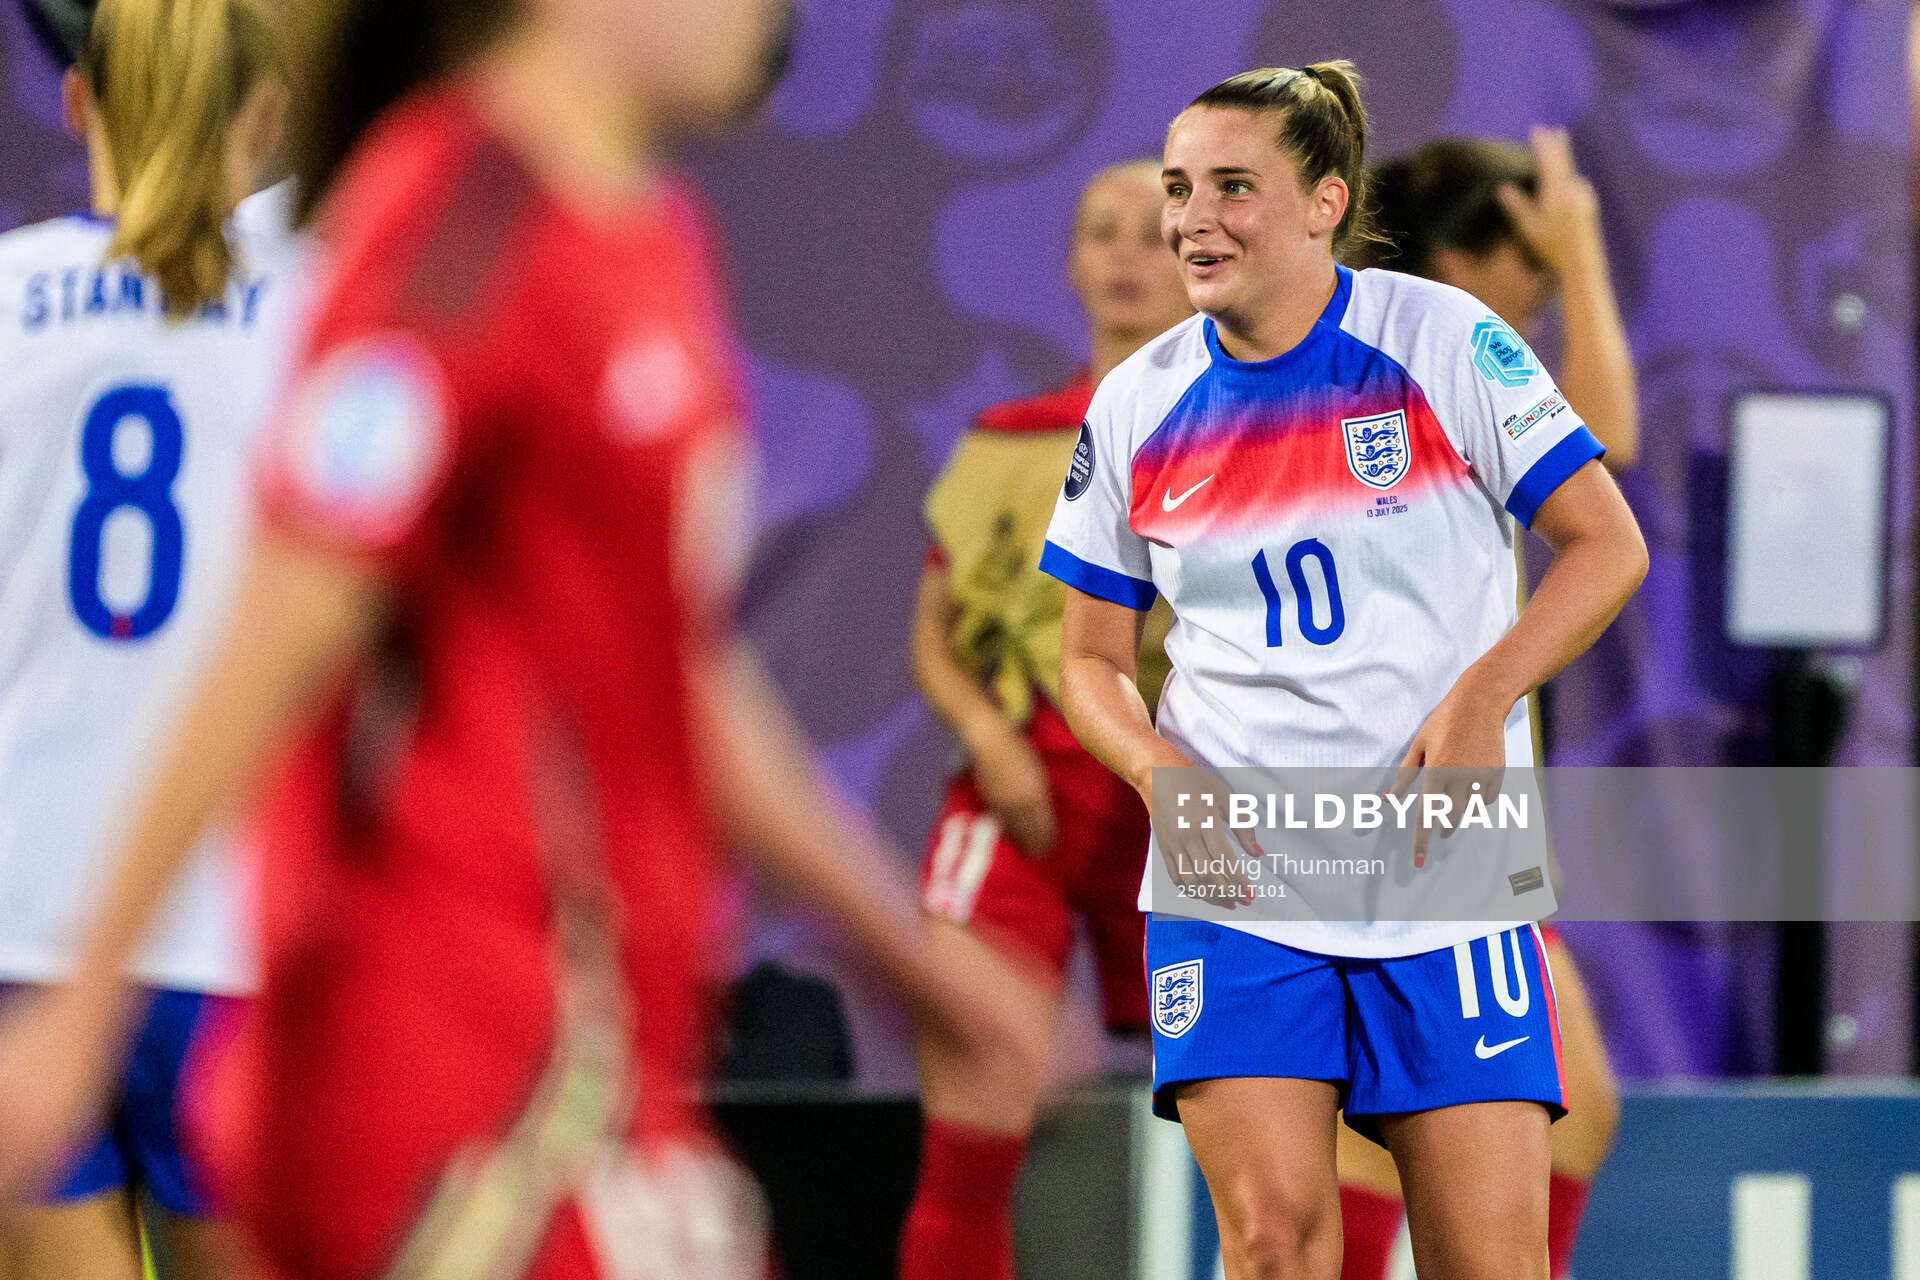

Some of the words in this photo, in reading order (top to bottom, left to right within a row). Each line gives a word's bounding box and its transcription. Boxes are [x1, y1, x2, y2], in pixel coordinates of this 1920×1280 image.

[22, 264, 267, 334] STANY
[1502, 413, 1518, 428] UEFA
[70, 381, 184, 638] 8
[1366, 509, 1374, 518] 13
[1375, 507, 1390, 517] JULY
[1391, 504, 1408, 514] 2025
[1376, 495, 1398, 505] WALES
[1251, 537, 1345, 647] 10
[1453, 927, 1530, 1019] 10
